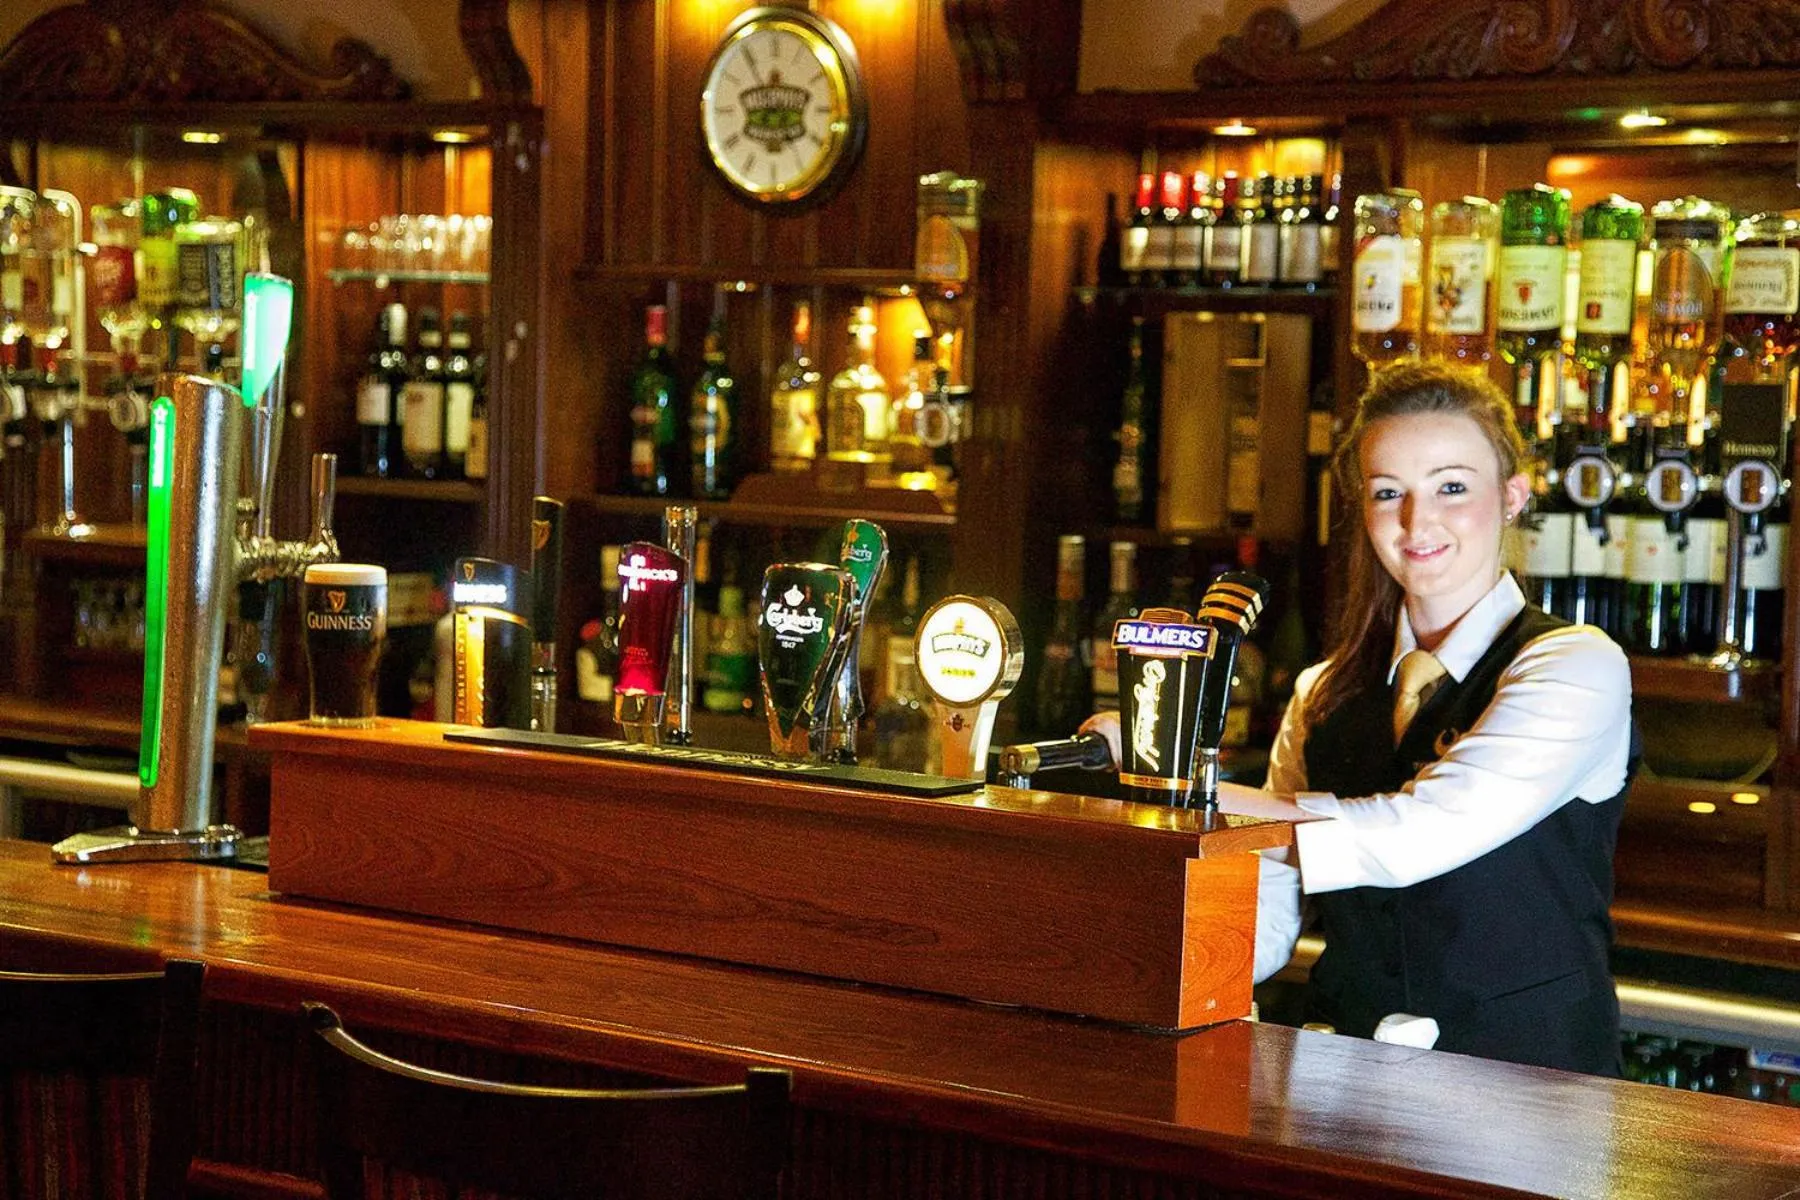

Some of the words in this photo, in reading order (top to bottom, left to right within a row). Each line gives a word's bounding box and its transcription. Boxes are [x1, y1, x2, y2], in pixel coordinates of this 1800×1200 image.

[307, 611, 373, 631] GUINNESS
[766, 602, 824, 635] Carlsberg
[1116, 623, 1208, 650] BULMERS
